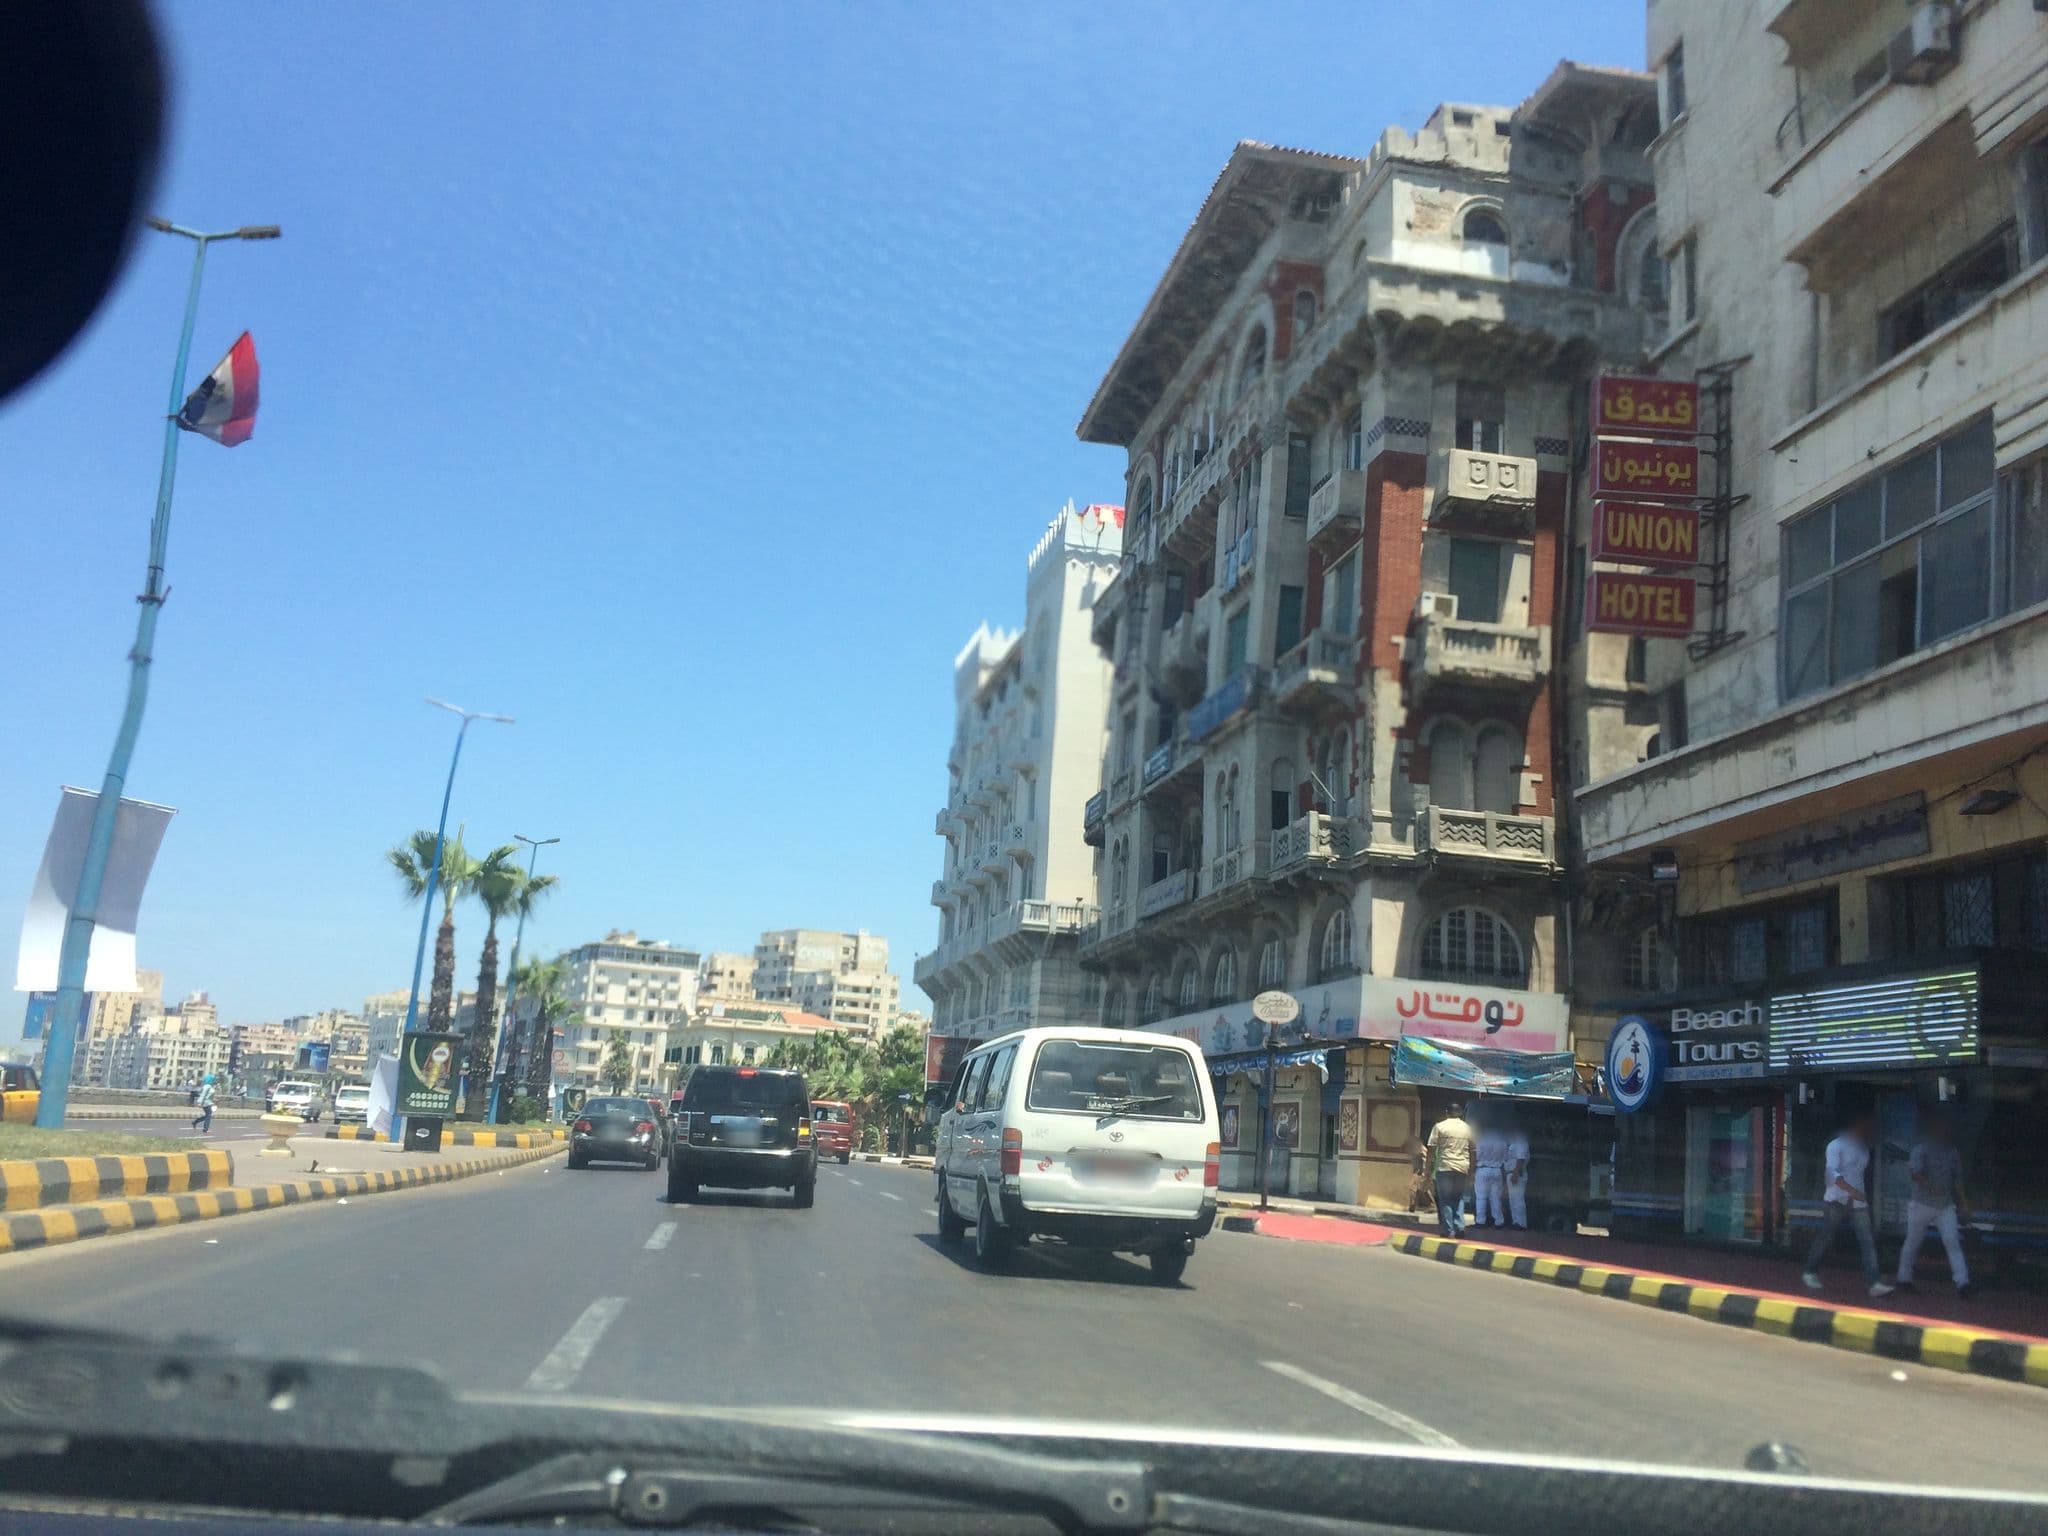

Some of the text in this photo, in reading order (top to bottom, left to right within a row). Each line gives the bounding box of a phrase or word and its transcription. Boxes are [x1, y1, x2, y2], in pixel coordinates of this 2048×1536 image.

[1604, 387, 1694, 425] فندق
[1604, 450, 1692, 486] يونيون
[1606, 510, 1693, 555] UNION
[1601, 582, 1688, 624] HOTEL
[1671, 1000, 1763, 1032] Beach
[1672, 1040, 1760, 1063] Tours
